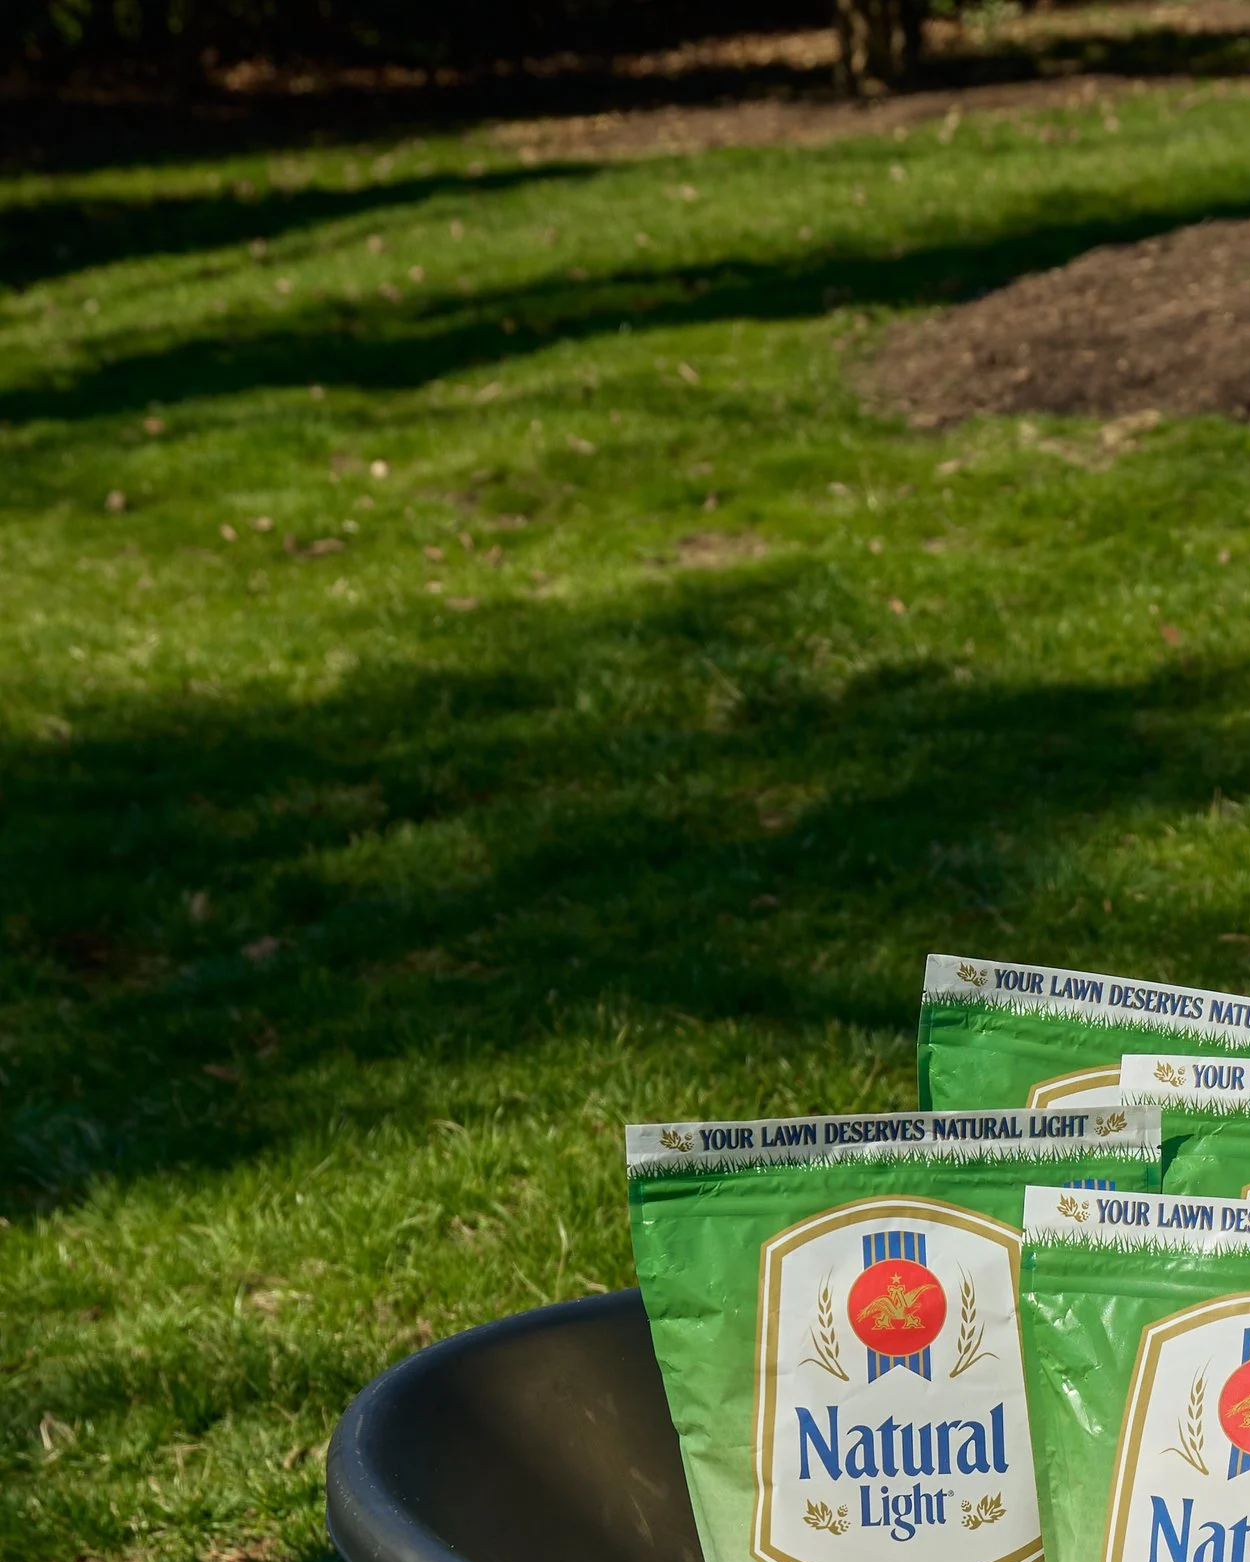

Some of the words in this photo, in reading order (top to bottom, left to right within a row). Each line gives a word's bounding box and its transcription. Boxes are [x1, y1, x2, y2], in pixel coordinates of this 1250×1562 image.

[994, 968, 1044, 995] YOUR
[1049, 976, 1102, 1004] LAWN
[1109, 984, 1203, 1020] DESERVES
[1192, 1064, 1244, 1090] YOUR
[700, 1127, 753, 1150] YOUR
[760, 1123, 817, 1147] LAWN
[824, 1118, 925, 1144] DESERVES
[931, 1117, 1022, 1140] NATURAL
[1028, 1114, 1089, 1137] LIGHT
[1096, 1198, 1150, 1226] YOUR
[1157, 1202, 1213, 1231] LAWN
[794, 1402, 1009, 1481] Natural
